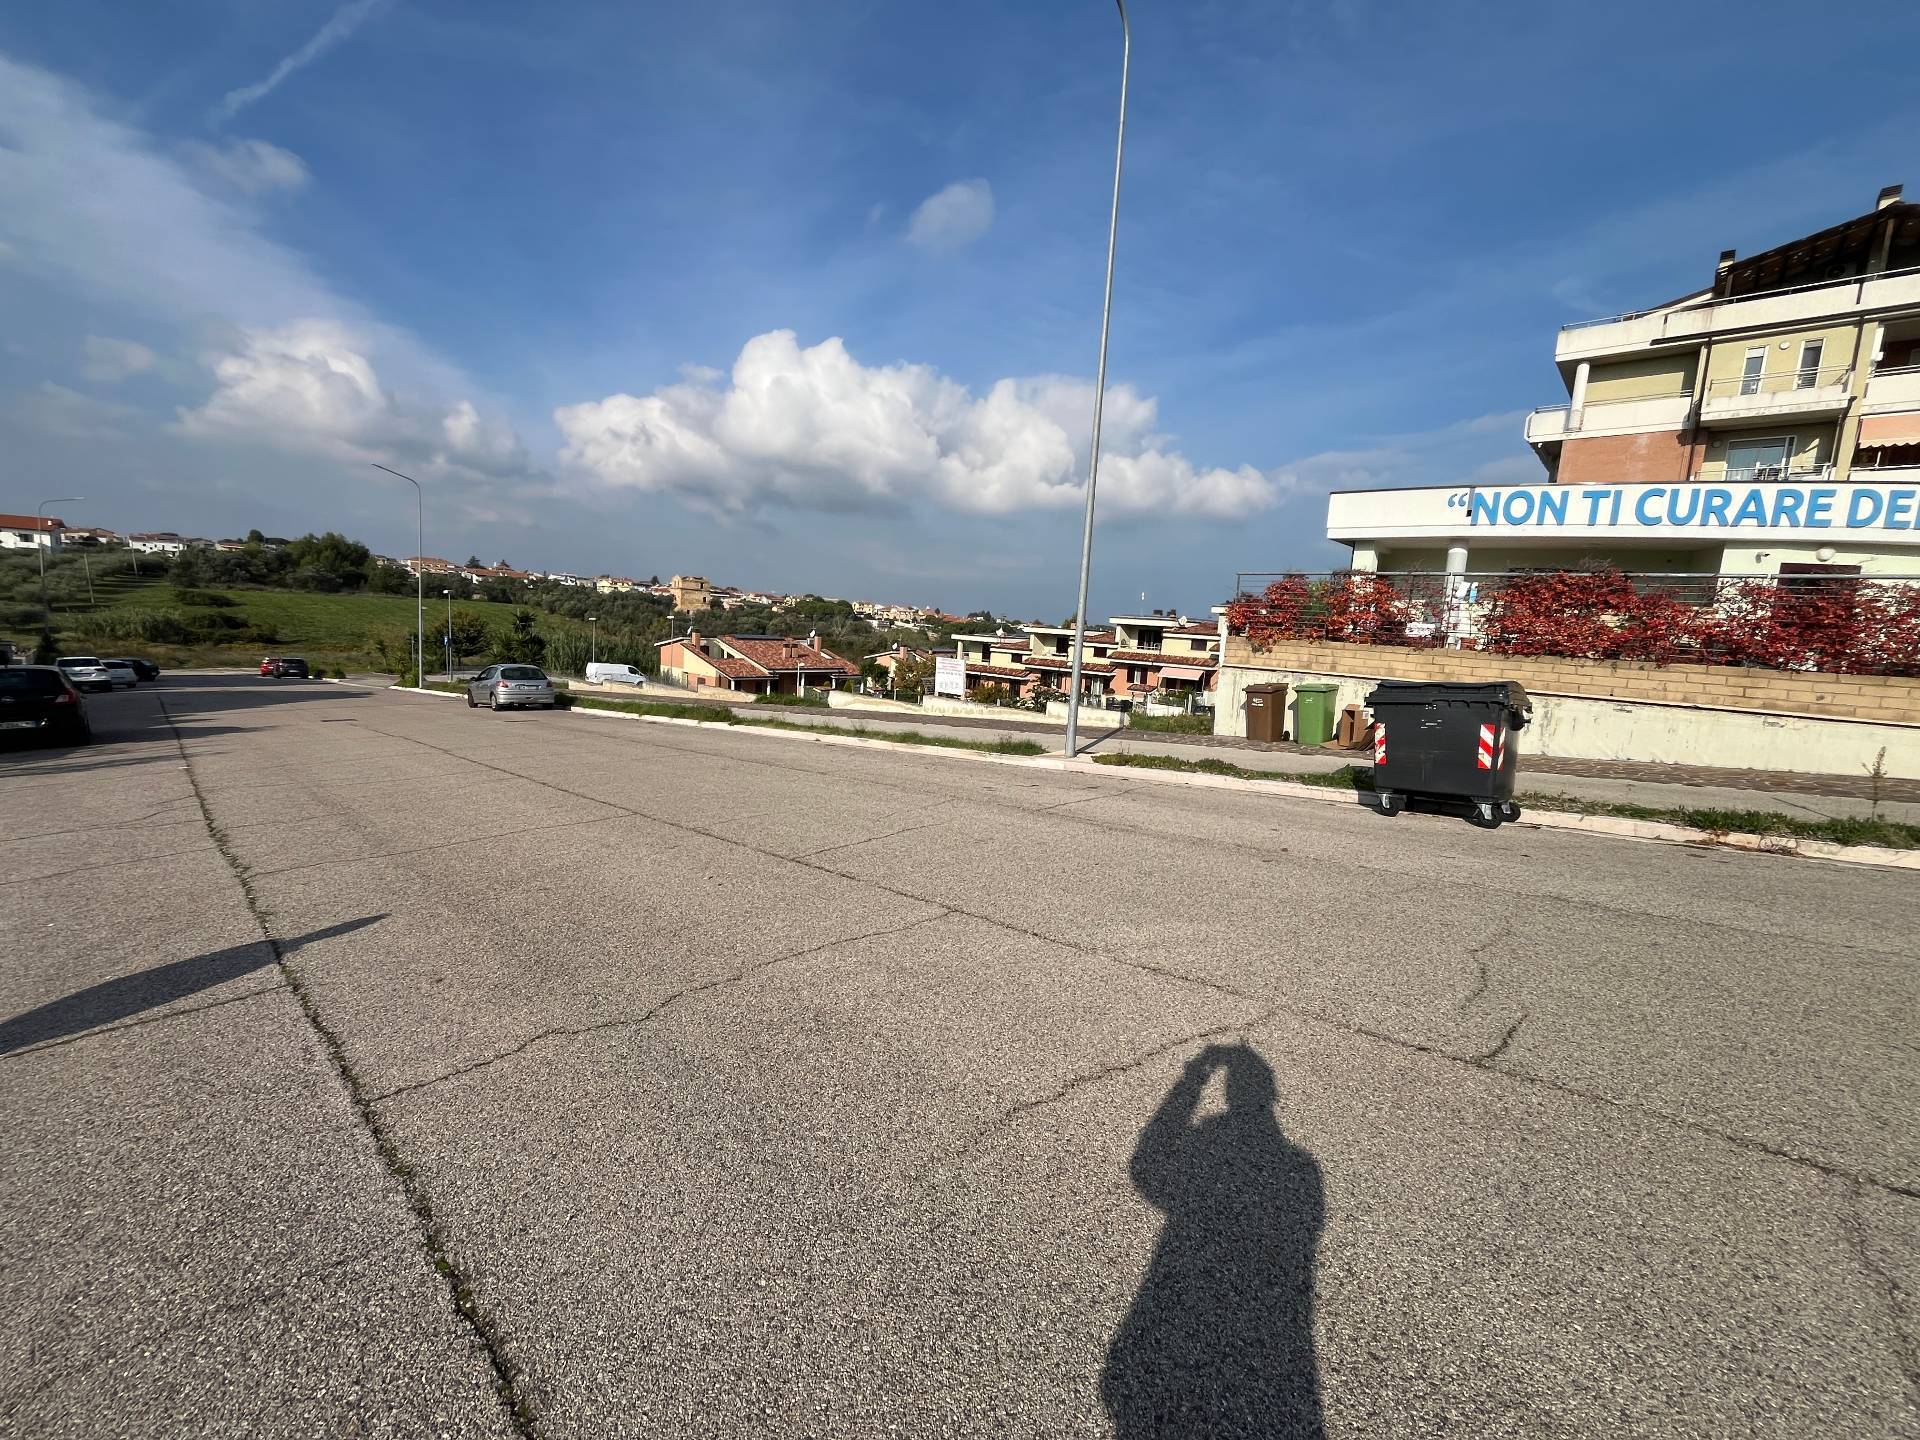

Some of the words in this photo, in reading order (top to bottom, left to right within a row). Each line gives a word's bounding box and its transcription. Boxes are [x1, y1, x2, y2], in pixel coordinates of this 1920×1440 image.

[1448, 489, 1570, 527] “NON
[1582, 489, 1623, 527] TI
[1634, 487, 1838, 528] CURARE
[1846, 488, 1920, 530] DE
